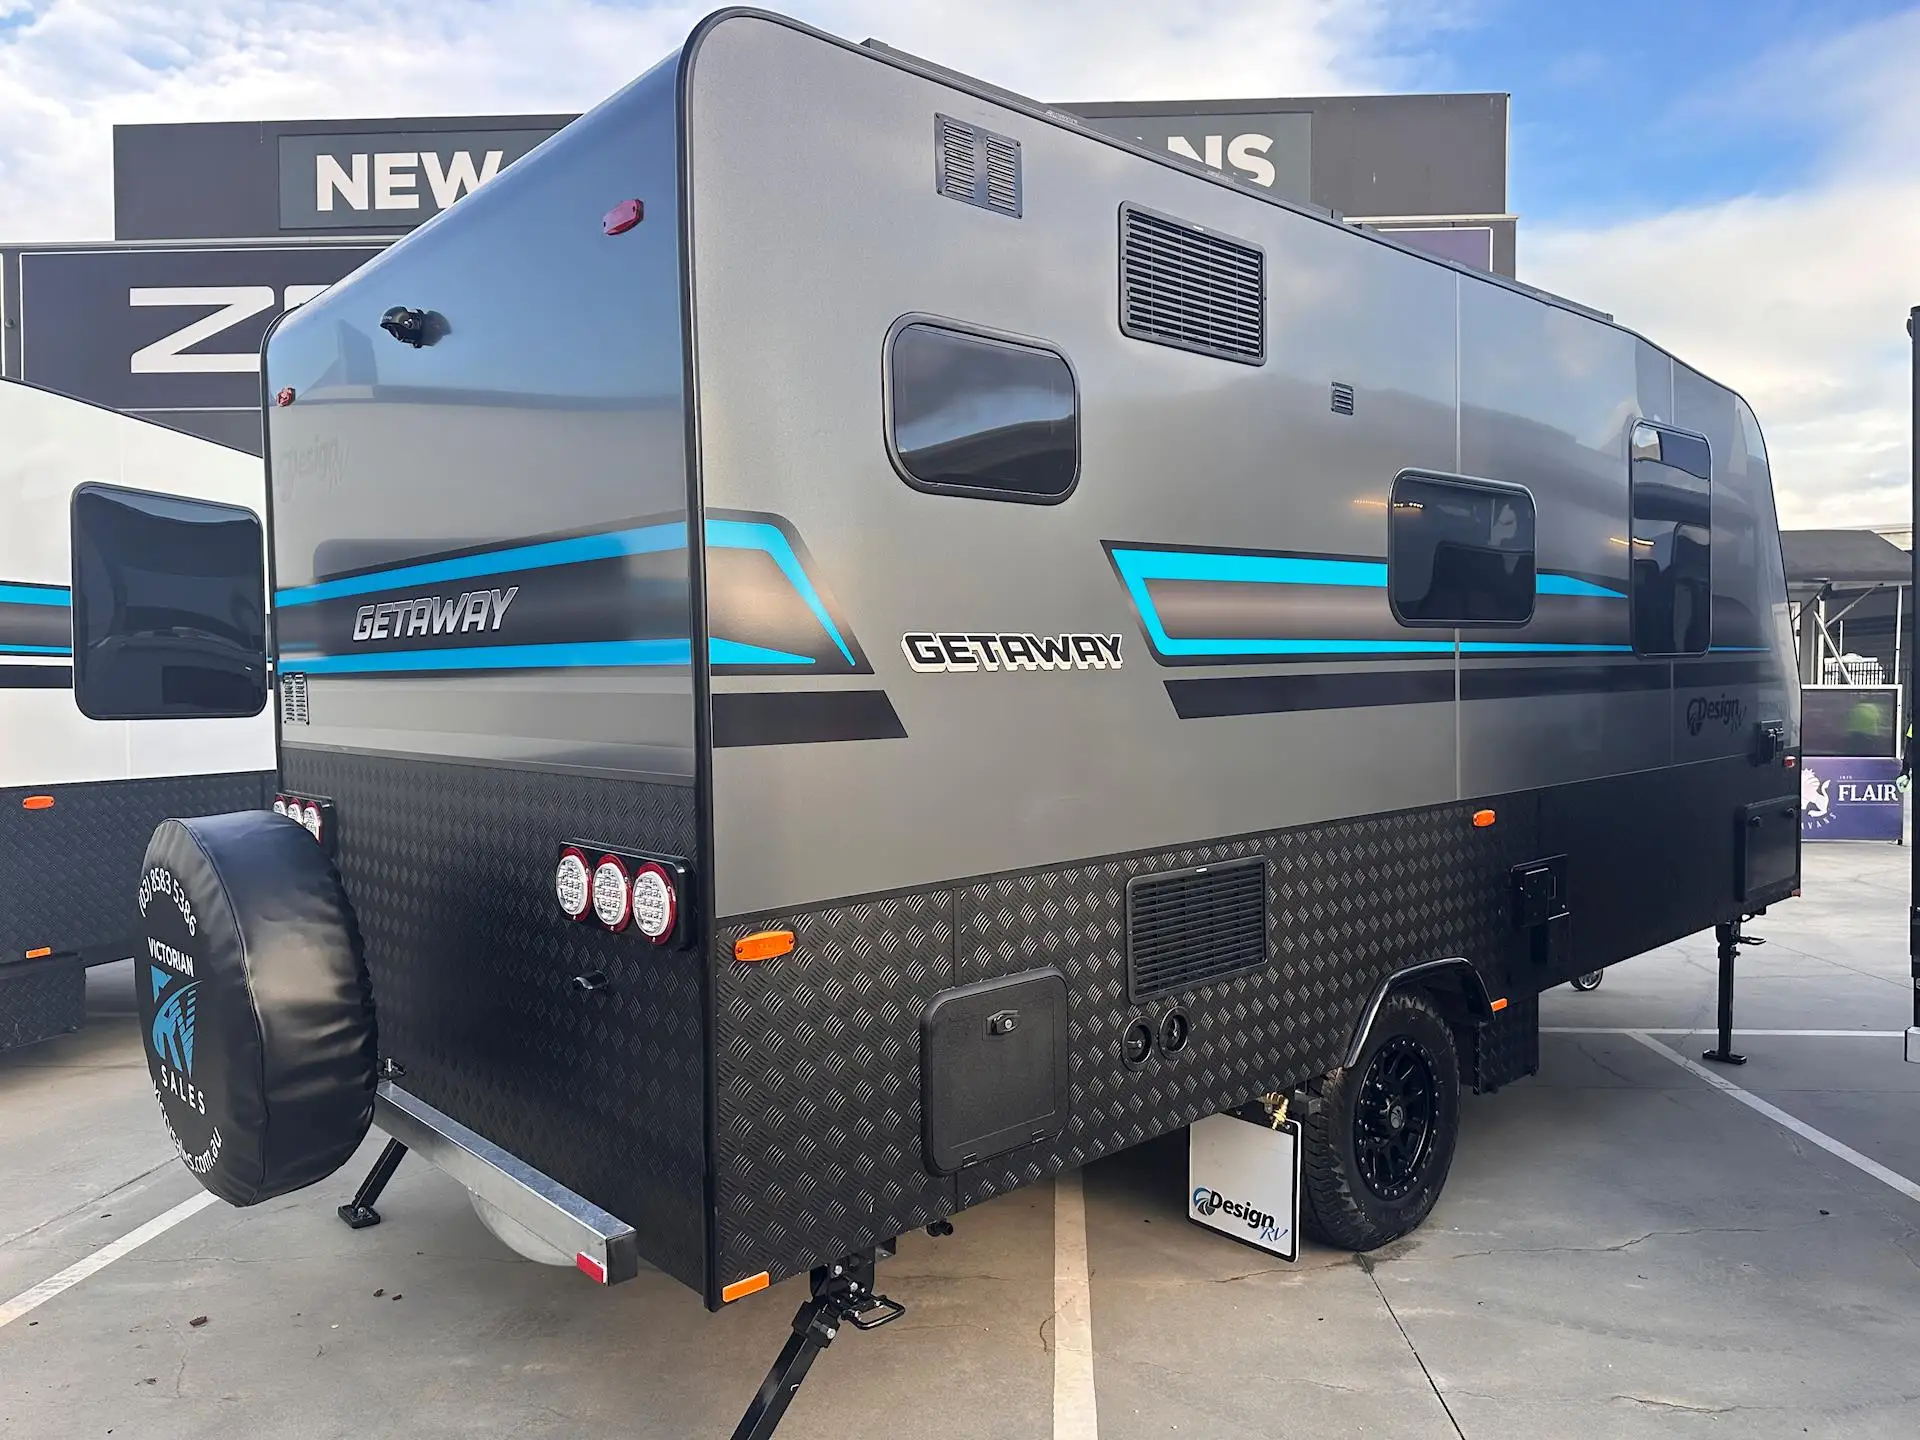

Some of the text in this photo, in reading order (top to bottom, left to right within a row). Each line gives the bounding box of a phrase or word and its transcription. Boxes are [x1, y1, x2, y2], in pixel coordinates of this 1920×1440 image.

[316, 150, 504, 212] NEW
[130, 284, 332, 374] Z
[352, 586, 520, 641] GETAWAY
[901, 632, 1123, 673] GETAWAY
[1699, 692, 1739, 726] Design
[1838, 784, 1899, 802] FLAIR
[138, 867, 197, 937] (03) 8583 5386
[147, 936, 195, 978] VICTORIAN
[161, 1064, 206, 1115] SALES
[1208, 1190, 1275, 1229] Design
[1260, 1227, 1289, 1242] RV
